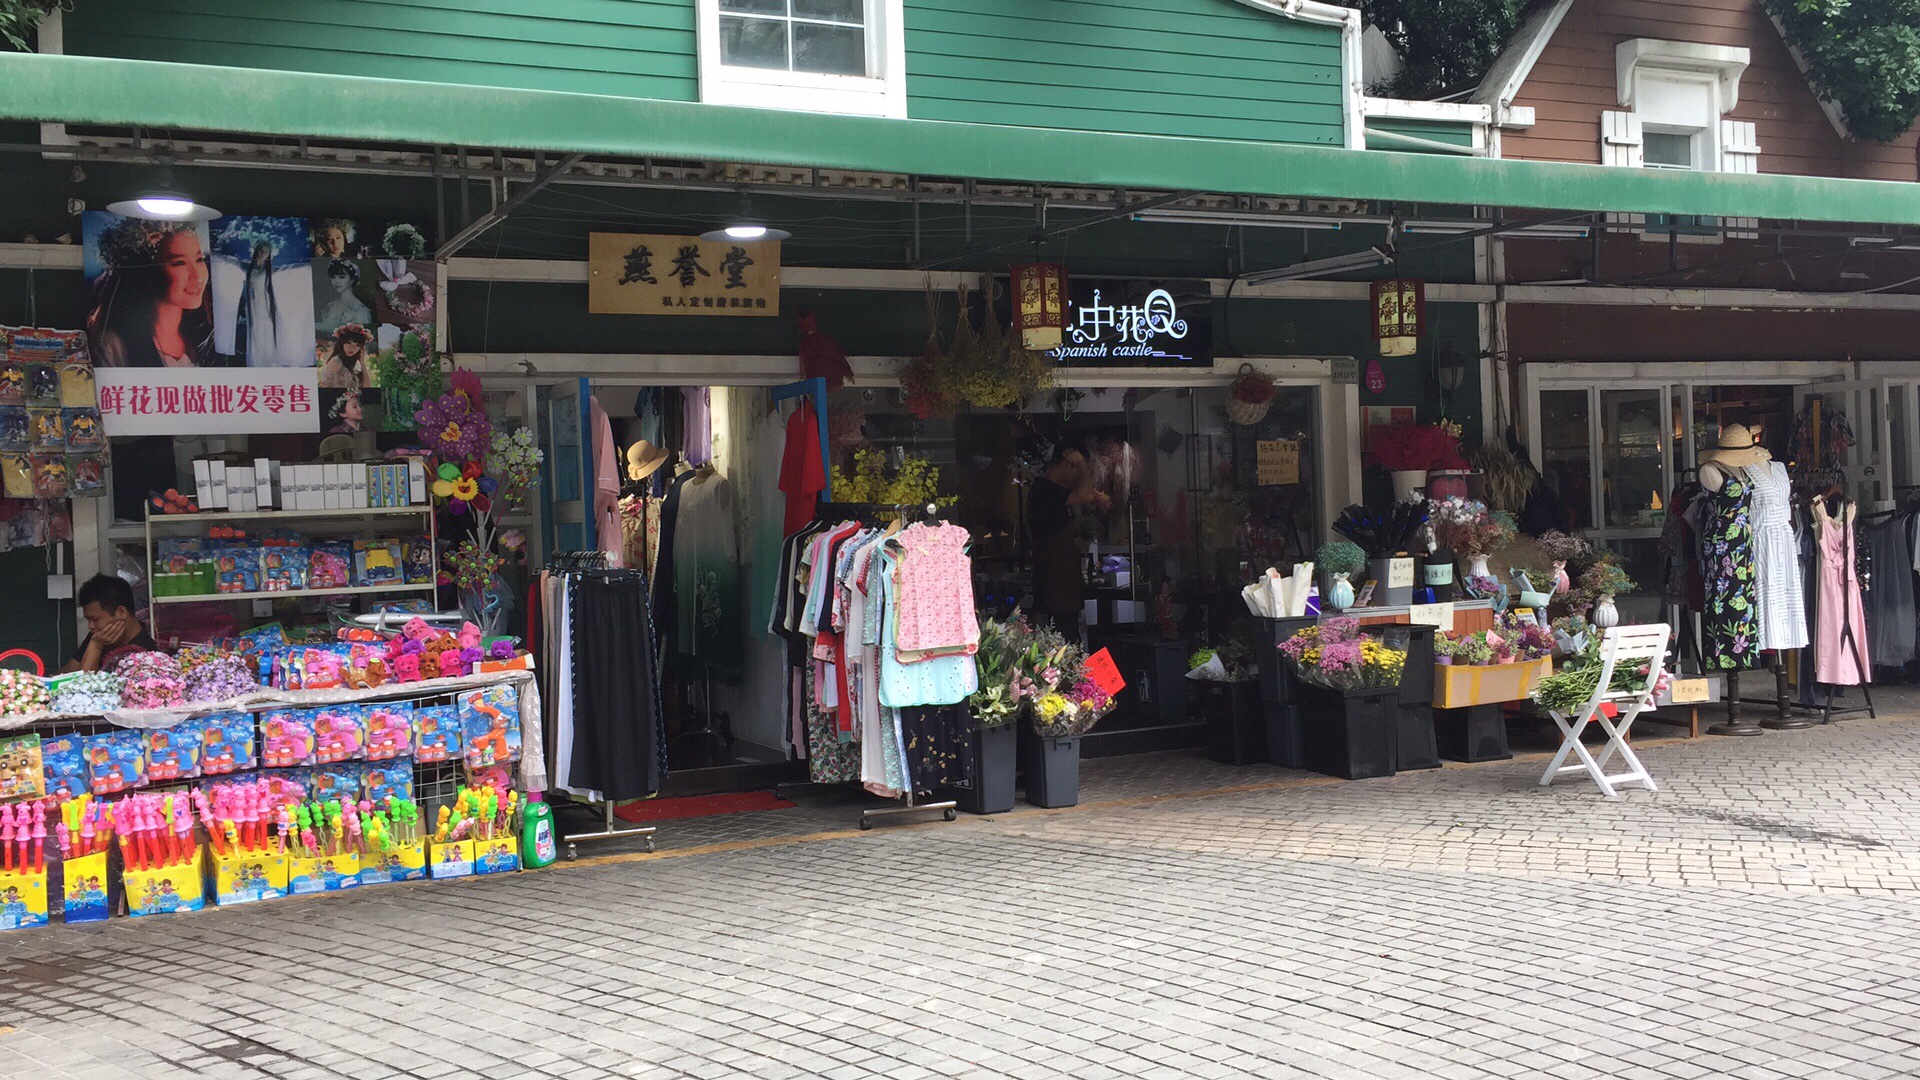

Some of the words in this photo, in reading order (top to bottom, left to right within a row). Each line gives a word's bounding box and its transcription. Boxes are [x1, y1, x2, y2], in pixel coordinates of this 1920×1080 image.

[1112, 343, 1153, 357] castle
[1371, 379, 1383, 389] 23
[100, 385, 312, 416] 鲜花现做批发零售
